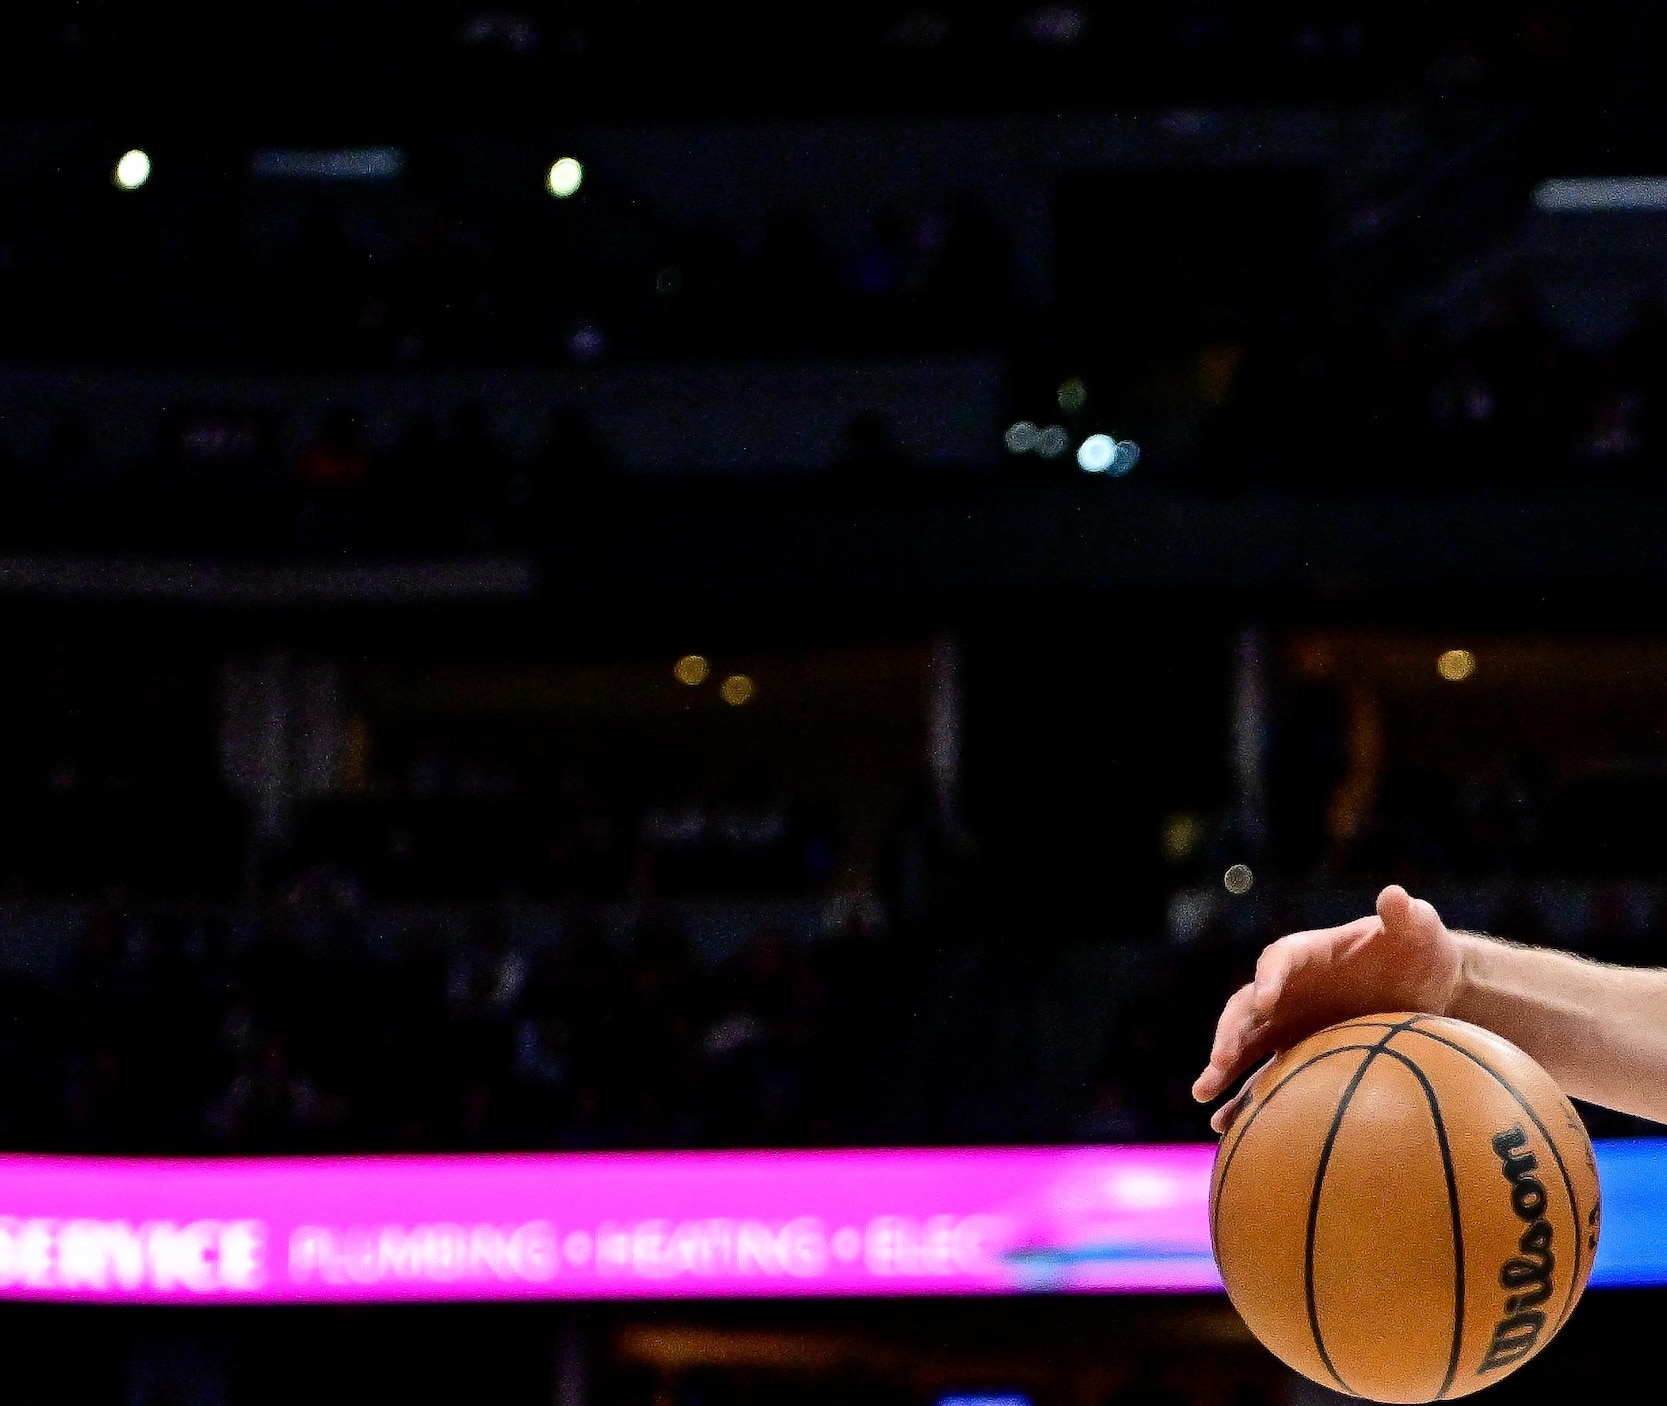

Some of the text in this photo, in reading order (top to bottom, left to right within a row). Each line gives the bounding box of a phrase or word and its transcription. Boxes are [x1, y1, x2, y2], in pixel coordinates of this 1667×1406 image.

[288, 1221, 558, 1284] PLUMBING
[596, 1216, 827, 1279] HEATING
[1477, 1123, 1554, 1376] Wilson
